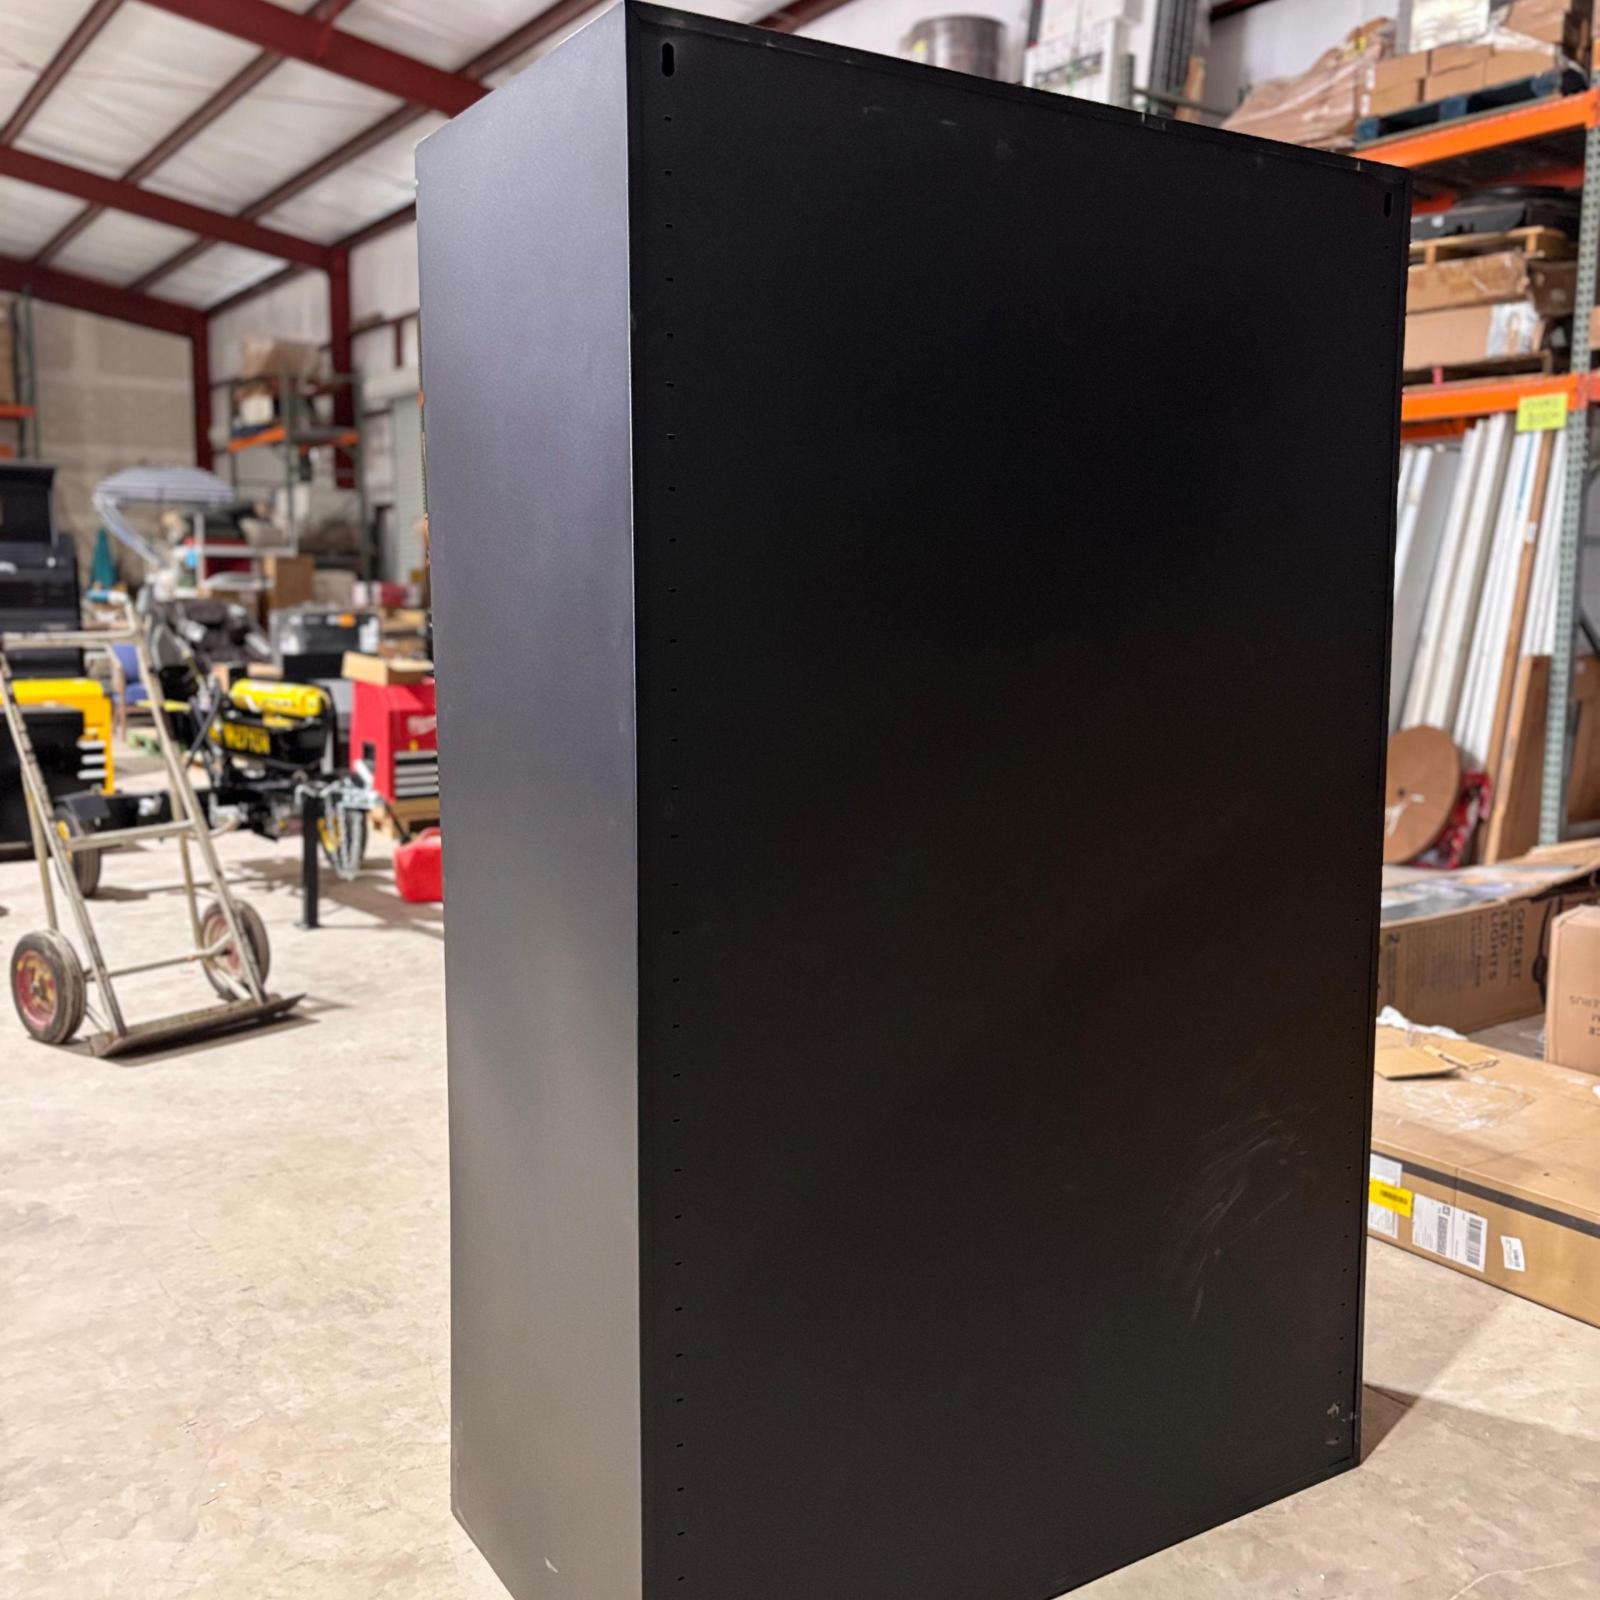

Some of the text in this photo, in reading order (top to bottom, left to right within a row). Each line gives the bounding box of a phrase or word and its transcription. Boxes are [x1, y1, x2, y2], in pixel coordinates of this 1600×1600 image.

[1487, 911, 1499, 981] LIGHTS
[1500, 909, 1509, 947] LED
[1513, 908, 1525, 980] OFFSET
